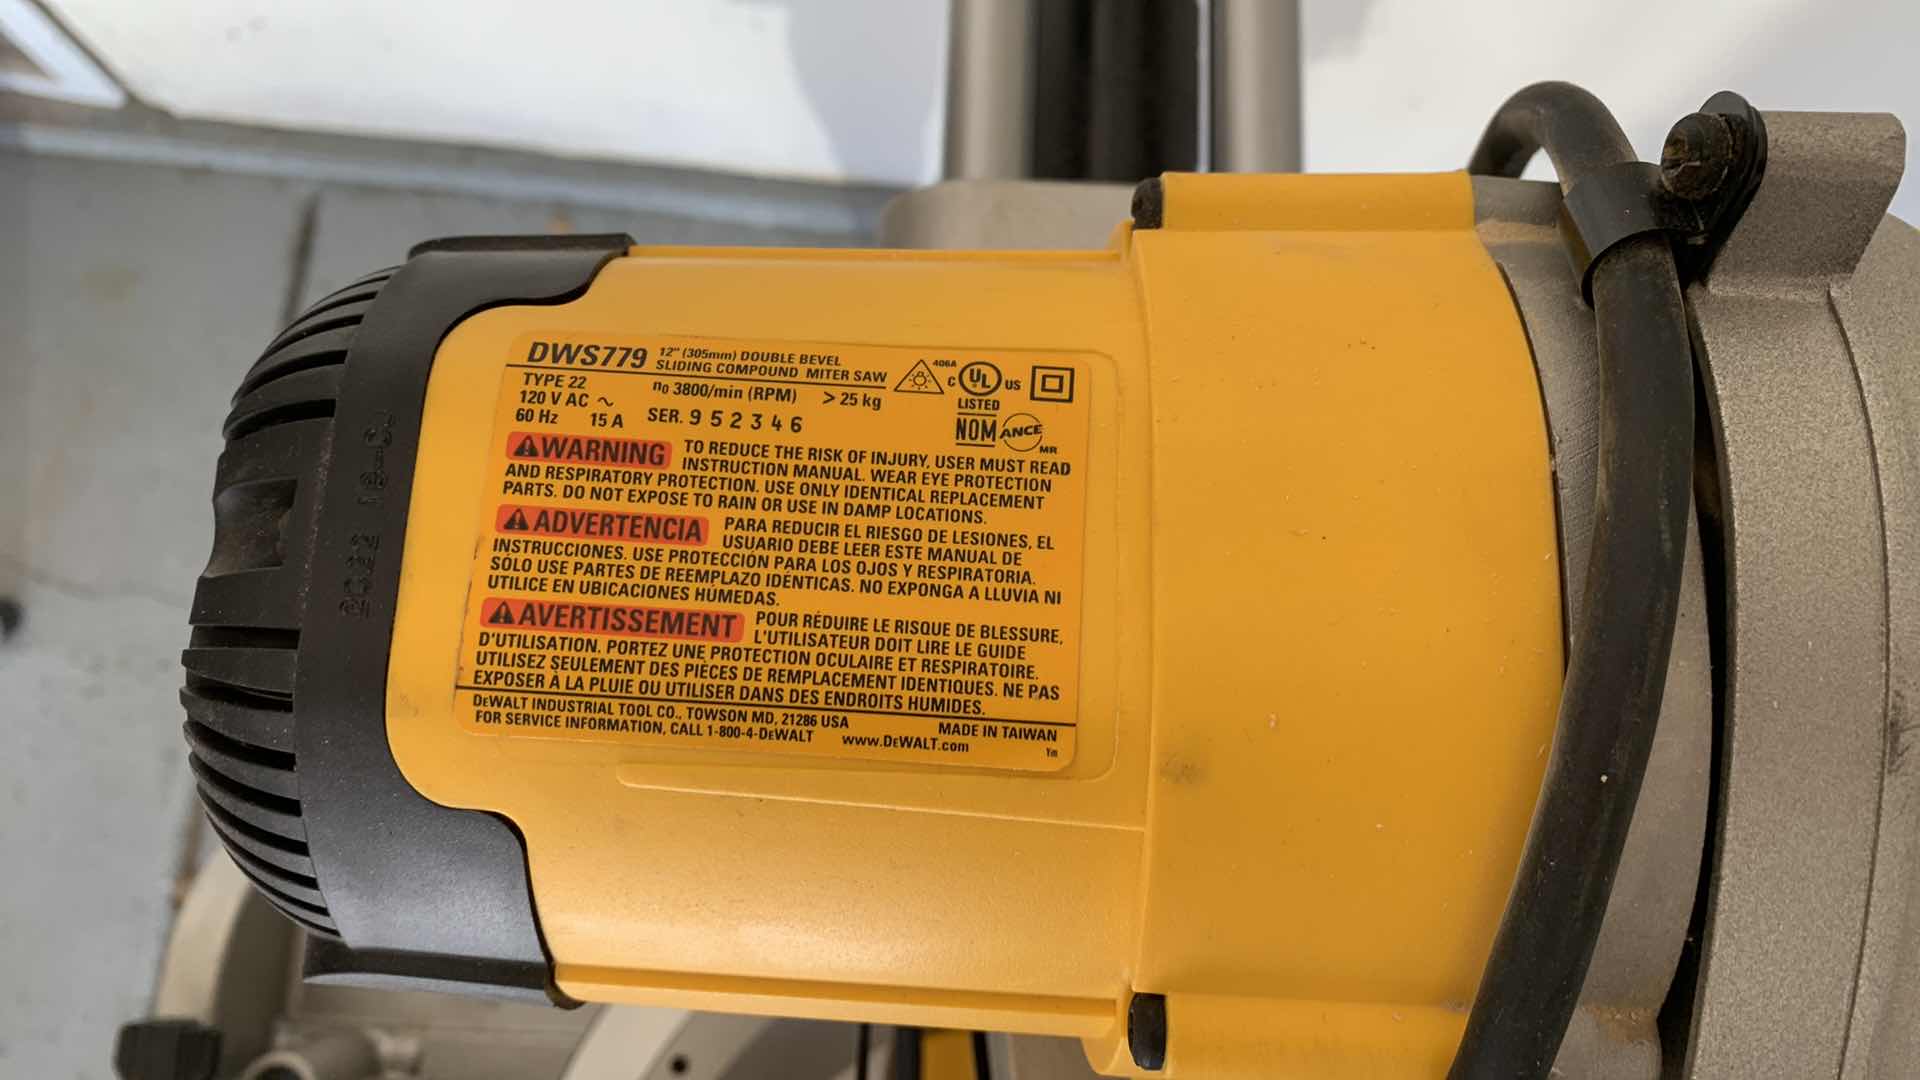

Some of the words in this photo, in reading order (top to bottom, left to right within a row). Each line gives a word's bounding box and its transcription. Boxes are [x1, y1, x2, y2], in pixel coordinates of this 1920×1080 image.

[527, 341, 648, 369] DWS779
[682, 347, 737, 362] (305mm)
[740, 351, 796, 364] DOUBLE
[799, 354, 841, 366] BEVEL
[524, 372, 565, 388] TYPE
[568, 376, 587, 389] 22
[656, 359, 712, 373] SLIDING
[716, 363, 799, 378] COMPOUND
[806, 368, 849, 381] MITER
[853, 370, 887, 383] SAW
[1005, 379, 1021, 391] US
[520, 390, 546, 405] 120
[565, 392, 589, 407] AC
[673, 382, 743, 399] 3800/min
[748, 386, 797, 404] (RPM)
[840, 392, 858, 406] 25
[862, 393, 881, 411] kg
[958, 398, 1000, 411] LISTED
[515, 408, 534, 422] 60
[539, 409, 558, 424] Hz
[591, 413, 607, 427] 15
[648, 407, 682, 424] SER.
[955, 417, 997, 442] NOM
[999, 424, 1043, 439] ANCE
[542, 437, 664, 465] WARNING
[684, 439, 704, 454] TO
[708, 441, 770, 458] REDUCE
[774, 445, 803, 460] THE
[808, 447, 843, 463] RISK
[848, 450, 867, 464] OF
[871, 451, 930, 469] INJURY,
[935, 455, 975, 470] USER
[980, 457, 1025, 473] MUST
[1030, 460, 1071, 476] READ
[505, 463, 540, 478] AND
[545, 465, 653, 485] RESPIRATORY
[657, 473, 759, 493] PROTECTION.
[765, 480, 795, 495] USE
[800, 482, 840, 497] ONLY
[844, 485, 925, 503] IDENTICAL
[930, 490, 1045, 509] REPLACEMENT
[682, 457, 788, 477] INSTRUCTION
[793, 464, 865, 482] MANUAL.
[870, 469, 917, 485] WEAR
[922, 472, 949, 487] EYE
[954, 473, 1051, 493] PROTECTION
[503, 480, 557, 497] PARTS.
[563, 484, 585, 499] DO
[590, 486, 624, 501] NOT
[627, 489, 689, 506] EXPOSE
[693, 493, 713, 508] TO
[718, 495, 757, 511] RAIN
[761, 497, 782, 512] OR
[787, 499, 817, 514] USE
[822, 501, 839, 516] IN
[843, 502, 892, 518] DAMP
[896, 505, 986, 524] LOCATIONS.
[534, 510, 701, 542] ADVERTENCIA
[724, 516, 767, 533] PARA
[772, 520, 840, 537] REDUCIR
[844, 524, 861, 539] EL
[866, 525, 923, 542] RIESGO
[928, 529, 947, 544] DE
[952, 530, 1032, 550] LESIONES,
[1037, 535, 1054, 550] EL
[493, 538, 627, 560] INSTRUCCIONES.
[633, 547, 664, 563] USE
[668, 549, 769, 569] PROTECCIÓN
[774, 556, 817, 573] PARA
[822, 558, 851, 574] LOS
[856, 560, 898, 577] OJOS
[917, 564, 1035, 585] RESPIRATORIA.
[723, 534, 793, 553] USUARIO
[798, 539, 840, 555] DEBE
[844, 542, 880, 557] LEER
[885, 544, 923, 560] ESTE
[927, 547, 997, 565] MANUAL
[1002, 551, 1022, 566] DE
[488, 574, 548, 592] UTILICE
[552, 578, 575, 594] EN
[579, 580, 690, 601] UBICACIONES
[695, 585, 779, 606] HÚMEDAS.
[490, 554, 532, 573] SÓLO
[537, 559, 569, 575] USE
[573, 561, 635, 579] PARTES
[640, 565, 661, 581] DE
[665, 567, 761, 587] REEMPLAZO
[766, 571, 854, 592] IDÉNTICAS.
[860, 579, 883, 594] NO
[888, 581, 964, 599] EXPONGA
[984, 587, 1039, 603] LLUVIA
[1044, 590, 1061, 605] NI
[518, 603, 737, 637] AVERTISSEMENT
[756, 611, 798, 627] POUR
[803, 612, 868, 632] RÉDUIRE
[873, 618, 890, 633] LE
[894, 619, 951, 637] RISQUE
[956, 623, 975, 638] DE
[980, 624, 1063, 645] BLESSURE,
[479, 632, 601, 653] D'UTILISATION.
[606, 639, 668, 657] PORTEZ
[672, 643, 705, 660] UNE
[710, 646, 811, 666] PROTECTION
[816, 652, 894, 671] OCULAIRE
[898, 657, 917, 672] ET
[921, 658, 1038, 680] RESPIRATOIRE.
[754, 629, 870, 650] L'UTILISATEUR
[875, 637, 913, 653] DOIT
[917, 639, 950, 656] LIRE
[955, 641, 972, 657] LE
[977, 643, 1026, 660] GUIDE
[476, 651, 546, 669] UTILISEZ
[550, 655, 646, 675] SEULEMENT
[649, 661, 679, 678] DES
[684, 661, 738, 681] PIÈCES
[743, 666, 763, 682] DE
[767, 668, 897, 690] REMPLACEMENT
[901, 676, 997, 696] IDENTIQUES.
[1003, 682, 1024, 698] NE
[1028, 684, 1060, 701] PAS
[473, 670, 545, 688] EXPOSER
[565, 675, 584, 691] LA
[589, 676, 634, 694] PLUIE
[638, 680, 661, 696] OU
[665, 681, 735, 700] UTILISER
[739, 686, 784, 703] DANS
[789, 688, 820, 705] DES
[824, 690, 903, 710] ENDROITS
[908, 696, 985, 715] HUMIDES.
[475, 709, 502, 724] FOR
[505, 712, 561, 728] SERVICE
[565, 716, 666, 735] INFORMATION,
[670, 722, 703, 736] CALL
[532, 698, 614, 715] INDUSTRIAL
[618, 703, 653, 717] TOOL
[686, 707, 748, 723] TOWSON
[751, 711, 778, 726] MD,
[781, 712, 818, 727] 21286
[821, 715, 849, 729] USA
[938, 722, 979, 737] MADE
[983, 725, 998, 738] IN
[1002, 726, 1057, 742] TAIWAN
